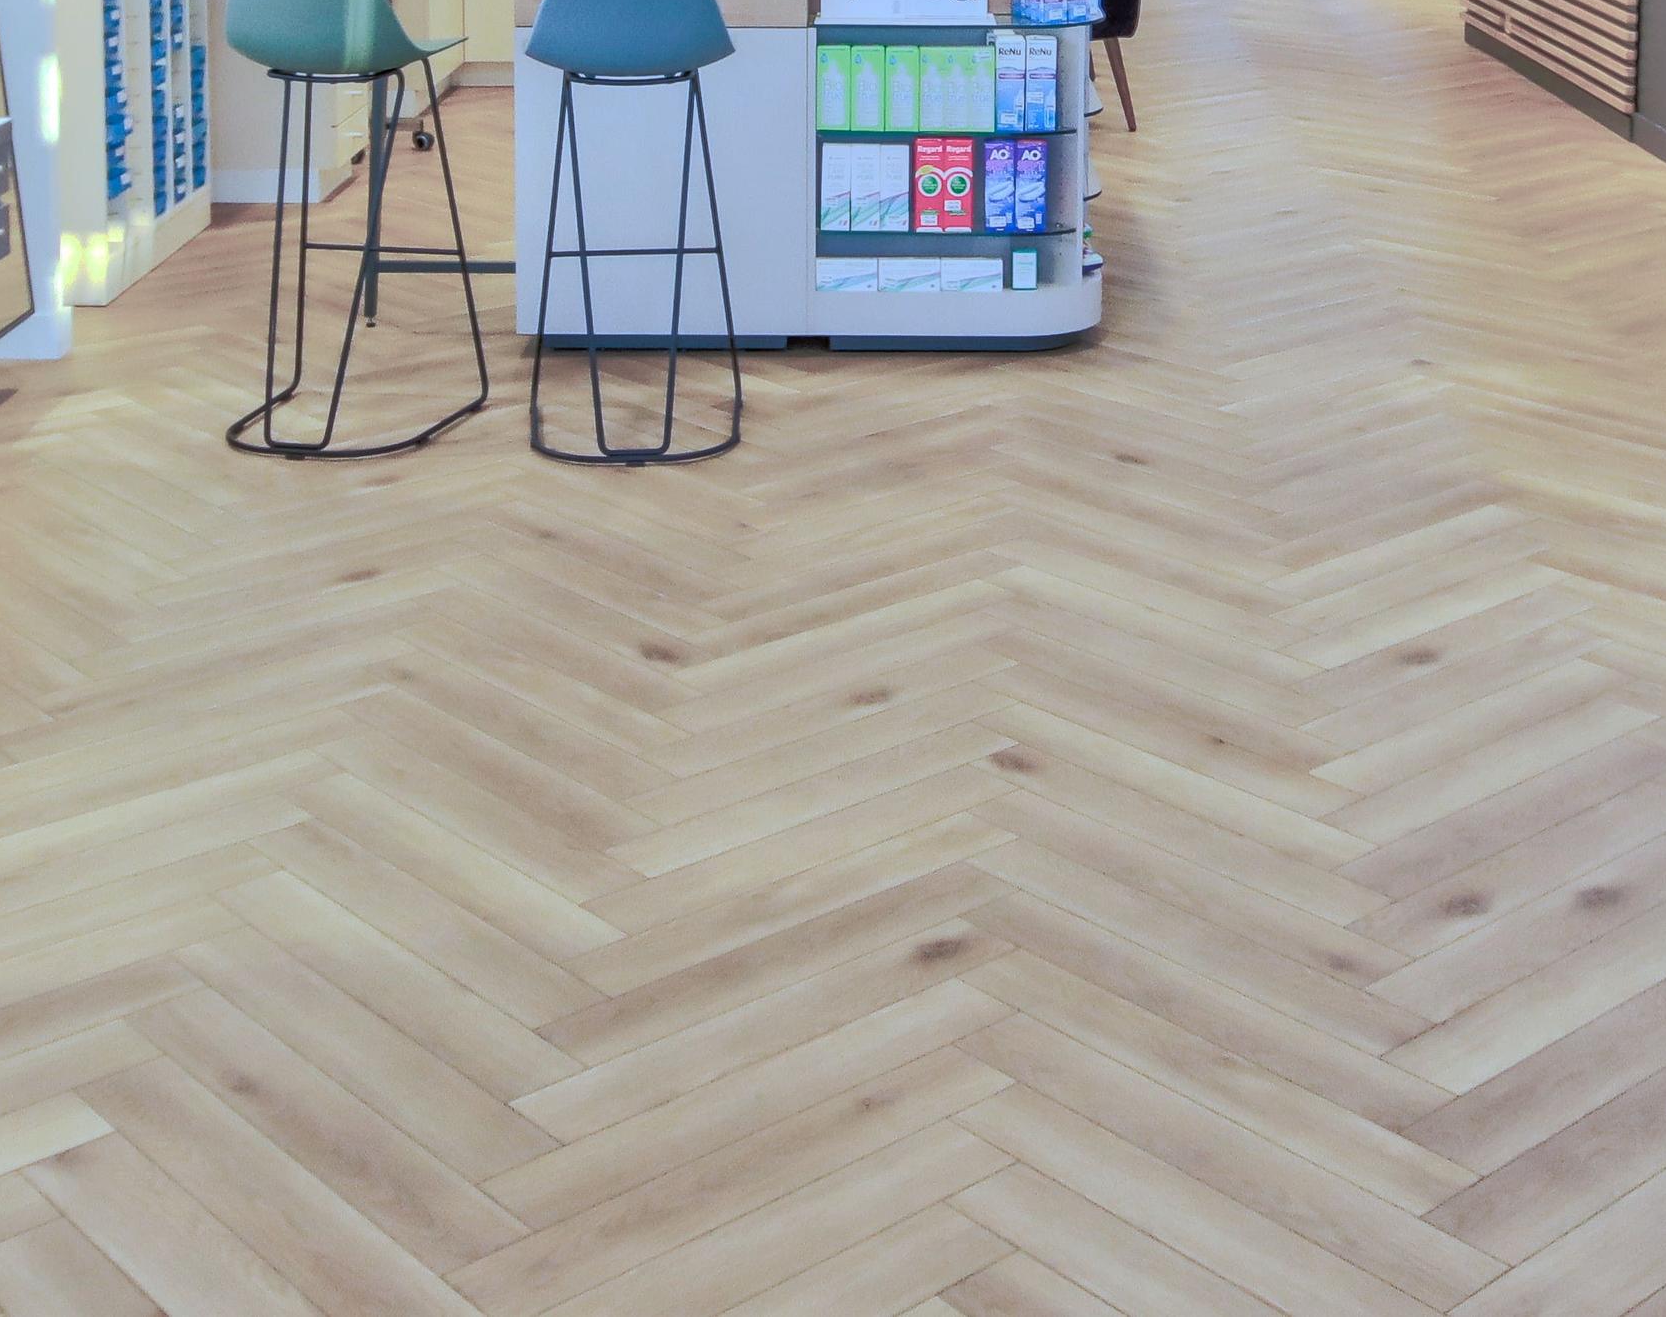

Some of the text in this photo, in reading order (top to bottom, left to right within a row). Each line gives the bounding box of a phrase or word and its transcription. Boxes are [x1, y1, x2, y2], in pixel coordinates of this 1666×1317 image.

[998, 46, 1022, 56] ReNu
[1030, 46, 1052, 56] ReNu
[917, 144, 943, 154] Regard
[946, 144, 972, 154] Regard
[990, 149, 1008, 160] AO
[1021, 149, 1041, 161] AO
